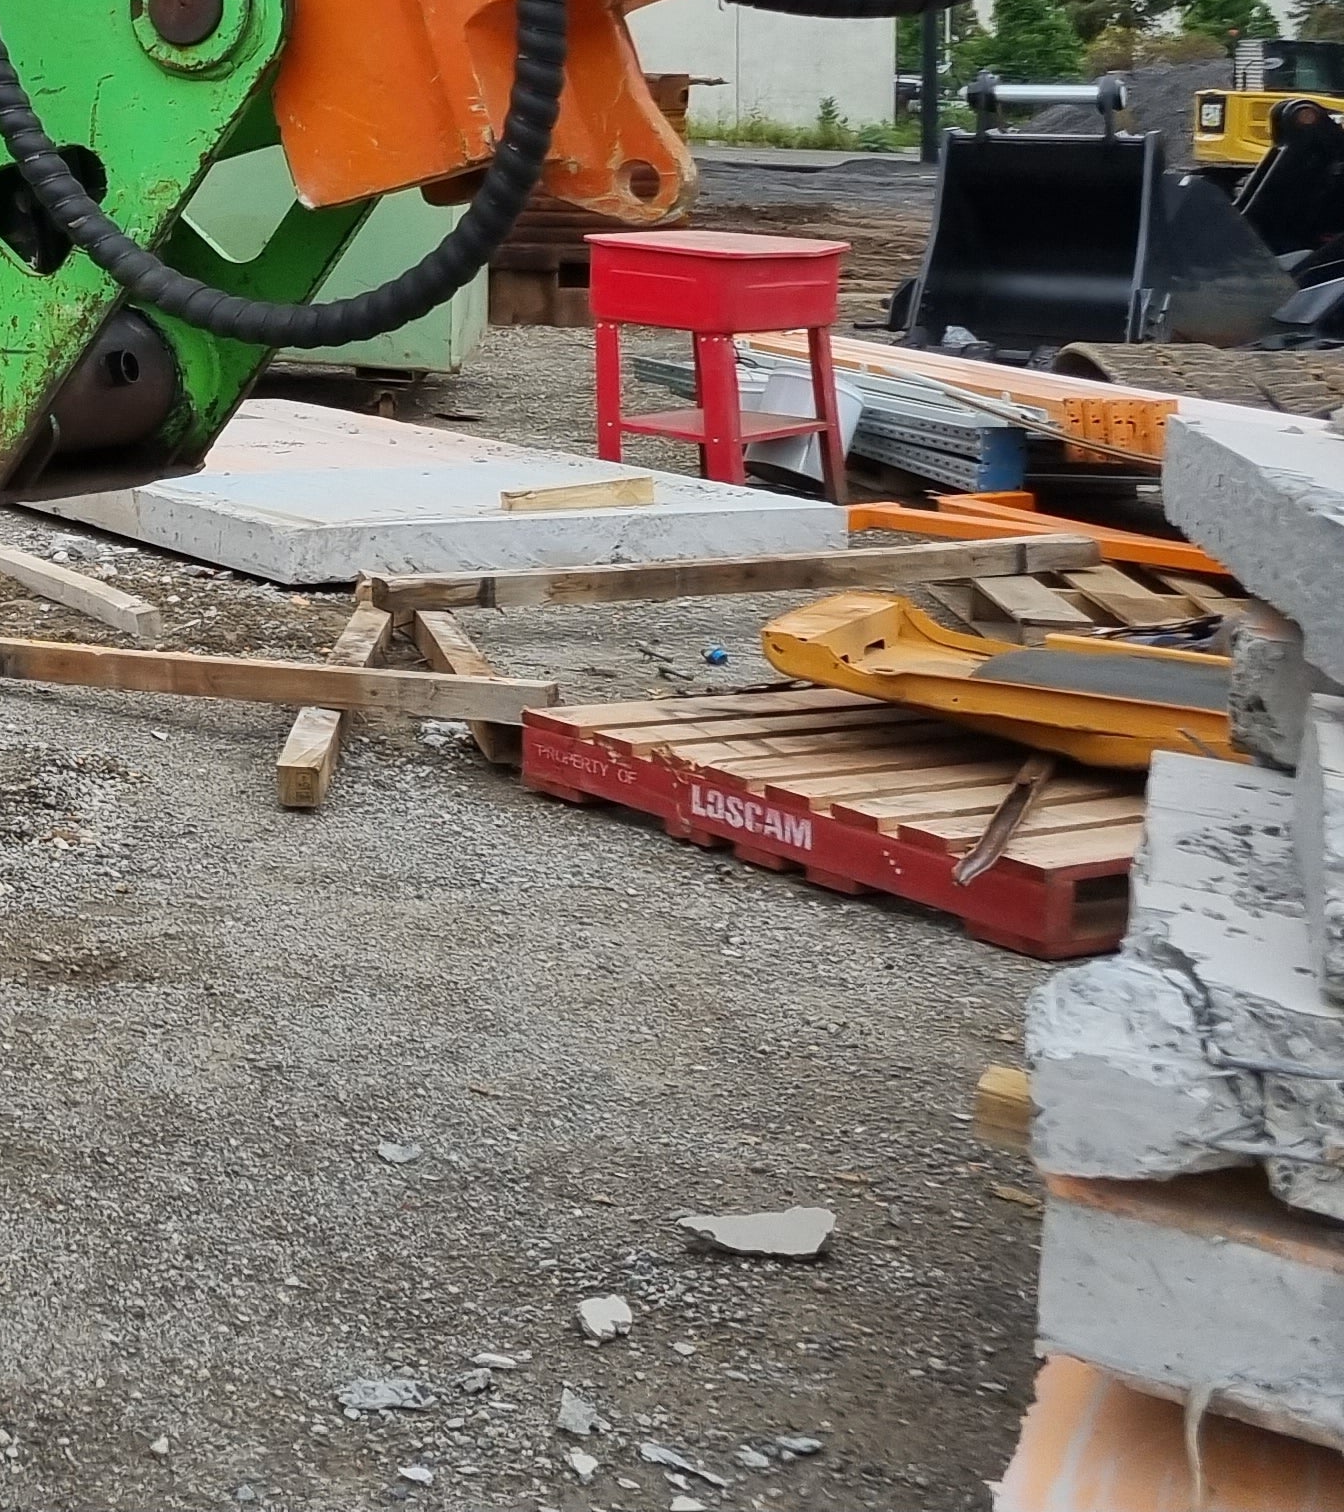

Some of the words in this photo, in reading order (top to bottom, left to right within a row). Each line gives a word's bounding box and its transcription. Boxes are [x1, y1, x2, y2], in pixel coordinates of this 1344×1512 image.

[534, 743, 609, 778] PROPERTY
[617, 767, 639, 786] OF
[690, 783, 814, 851] LOSCAM
